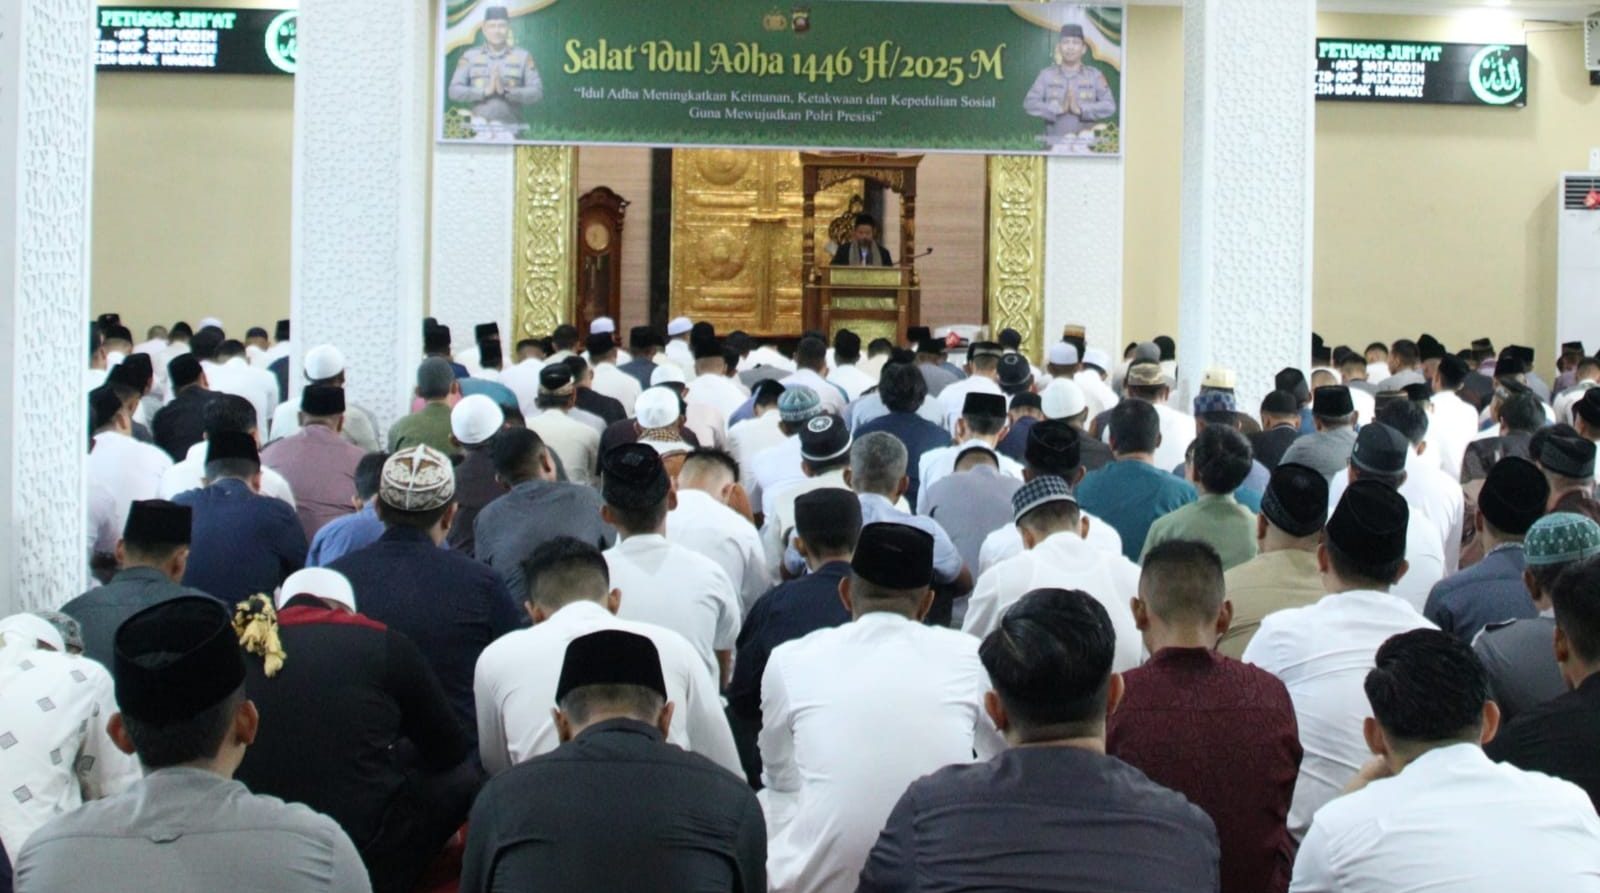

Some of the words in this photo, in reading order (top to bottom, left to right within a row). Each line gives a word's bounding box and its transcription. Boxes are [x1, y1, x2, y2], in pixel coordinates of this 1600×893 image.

[101, 11, 174, 28] PETUGAS
[563, 38, 637, 74] Salat
[641, 40, 701, 73] Idul
[705, 42, 784, 77] Adha
[792, 47, 853, 83] 1446
[968, 43, 1007, 80] M
[1319, 43, 1385, 59] PETUGAS
[1387, 45, 1442, 61] JUM'AT
[1361, 61, 1425, 73] SAIFUDDIN
[607, 87, 639, 100] Adha
[643, 88, 727, 104] Meningkatkan
[731, 90, 794, 105] Keimanan,
[797, 91, 863, 104] Ketakwaan
[866, 92, 887, 105] dan
[891, 93, 958, 109] Kepedulian
[961, 95, 996, 108] Sosial
[688, 107, 721, 119] Guna
[725, 107, 800, 122] Mewujudkan
[805, 110, 833, 121] Polri
